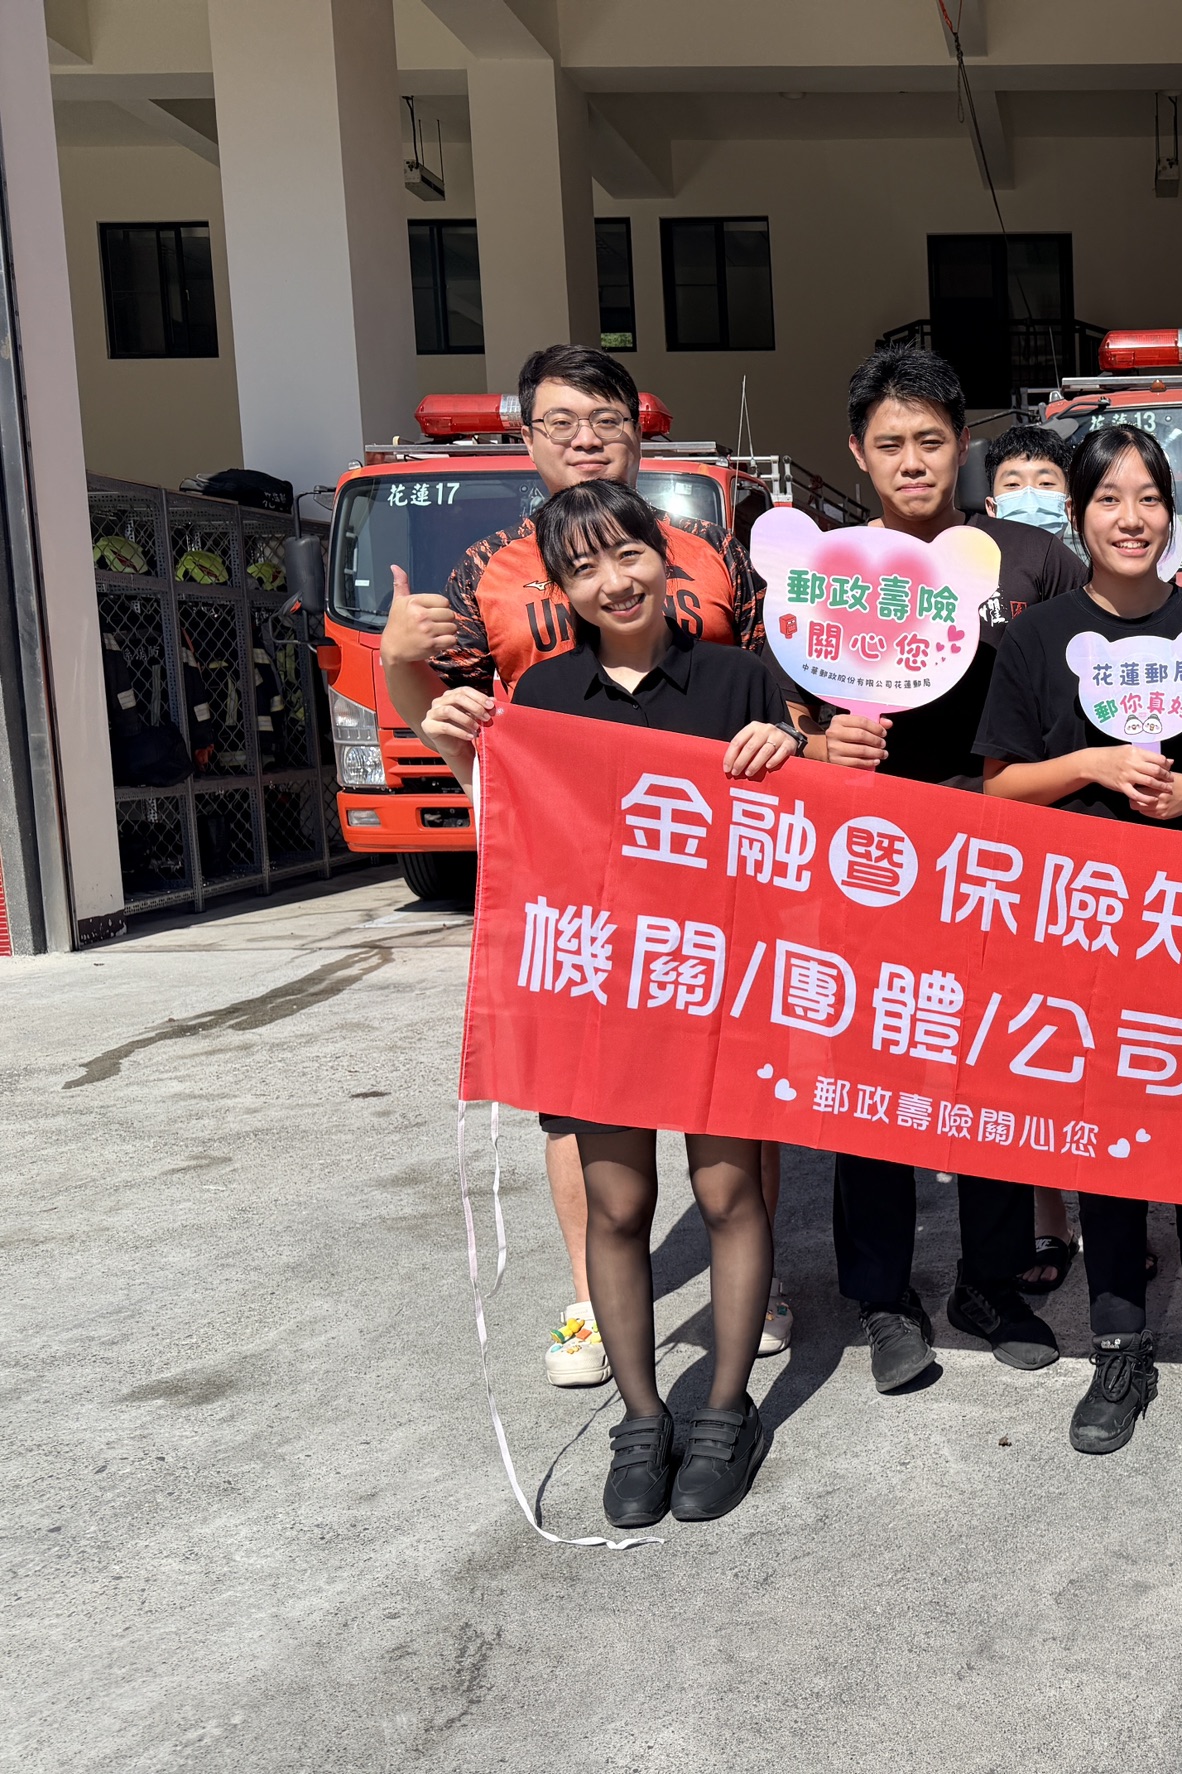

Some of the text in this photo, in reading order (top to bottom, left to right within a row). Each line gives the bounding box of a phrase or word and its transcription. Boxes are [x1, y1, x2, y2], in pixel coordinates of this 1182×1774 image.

[387, 482, 460, 507] 花蓮17
[786, 569, 959, 624] 郵政壽險
[807, 621, 931, 672] 關心您
[801, 663, 931, 689] 中華郵政股份有限公司花蓮郵局
[813, 1076, 1099, 1159] 郵政壽險關心您
